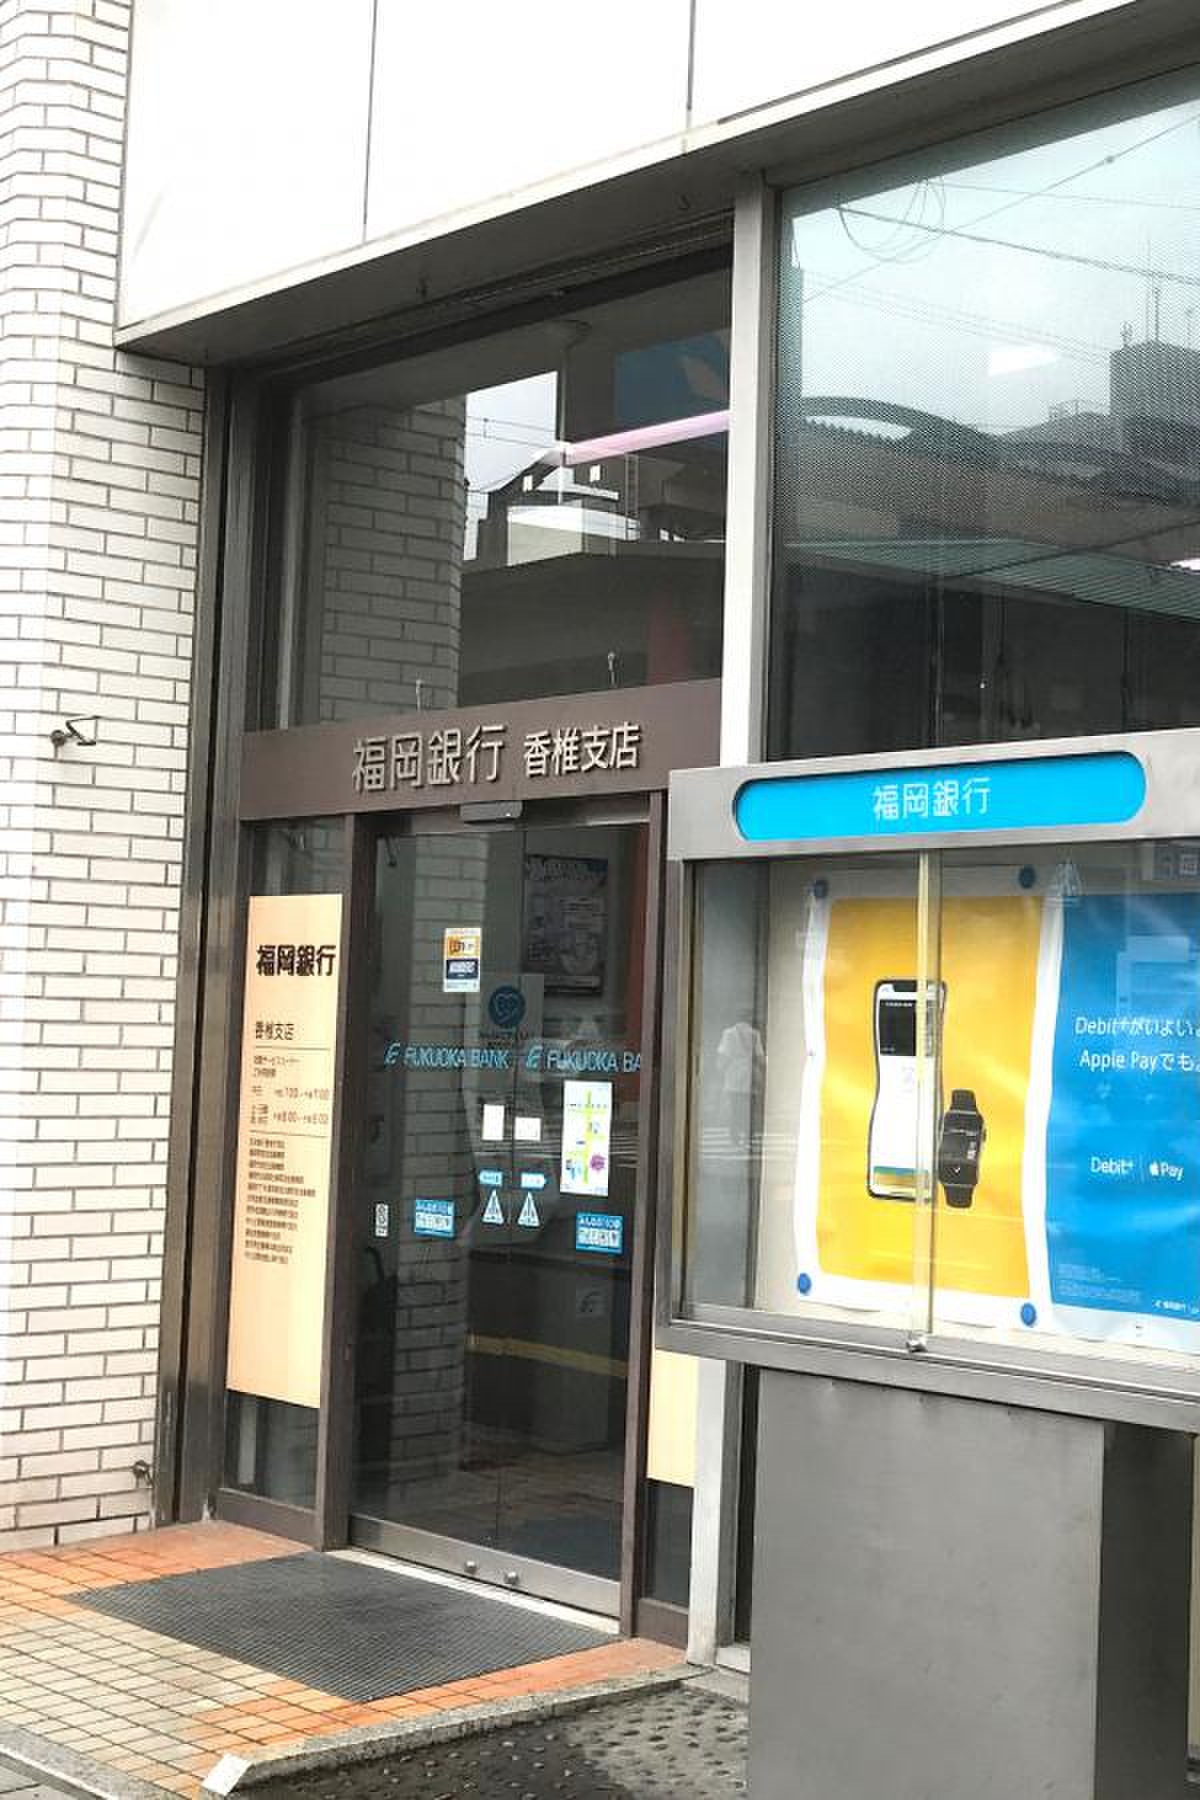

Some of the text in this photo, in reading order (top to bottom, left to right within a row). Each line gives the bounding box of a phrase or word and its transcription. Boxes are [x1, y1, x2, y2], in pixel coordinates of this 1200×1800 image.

[352, 721, 641, 791] 福岡銀行 香椎支店
[872, 777, 991, 820] 福岡銀行
[256, 944, 336, 976] 福岡銀行
[403, 1046, 509, 1069] FUKUOKA BANK
[546, 1047, 617, 1072] FUKUOKA
[1080, 1049, 1126, 1072] Apple
[1160, 1161, 1184, 1181] Pay
